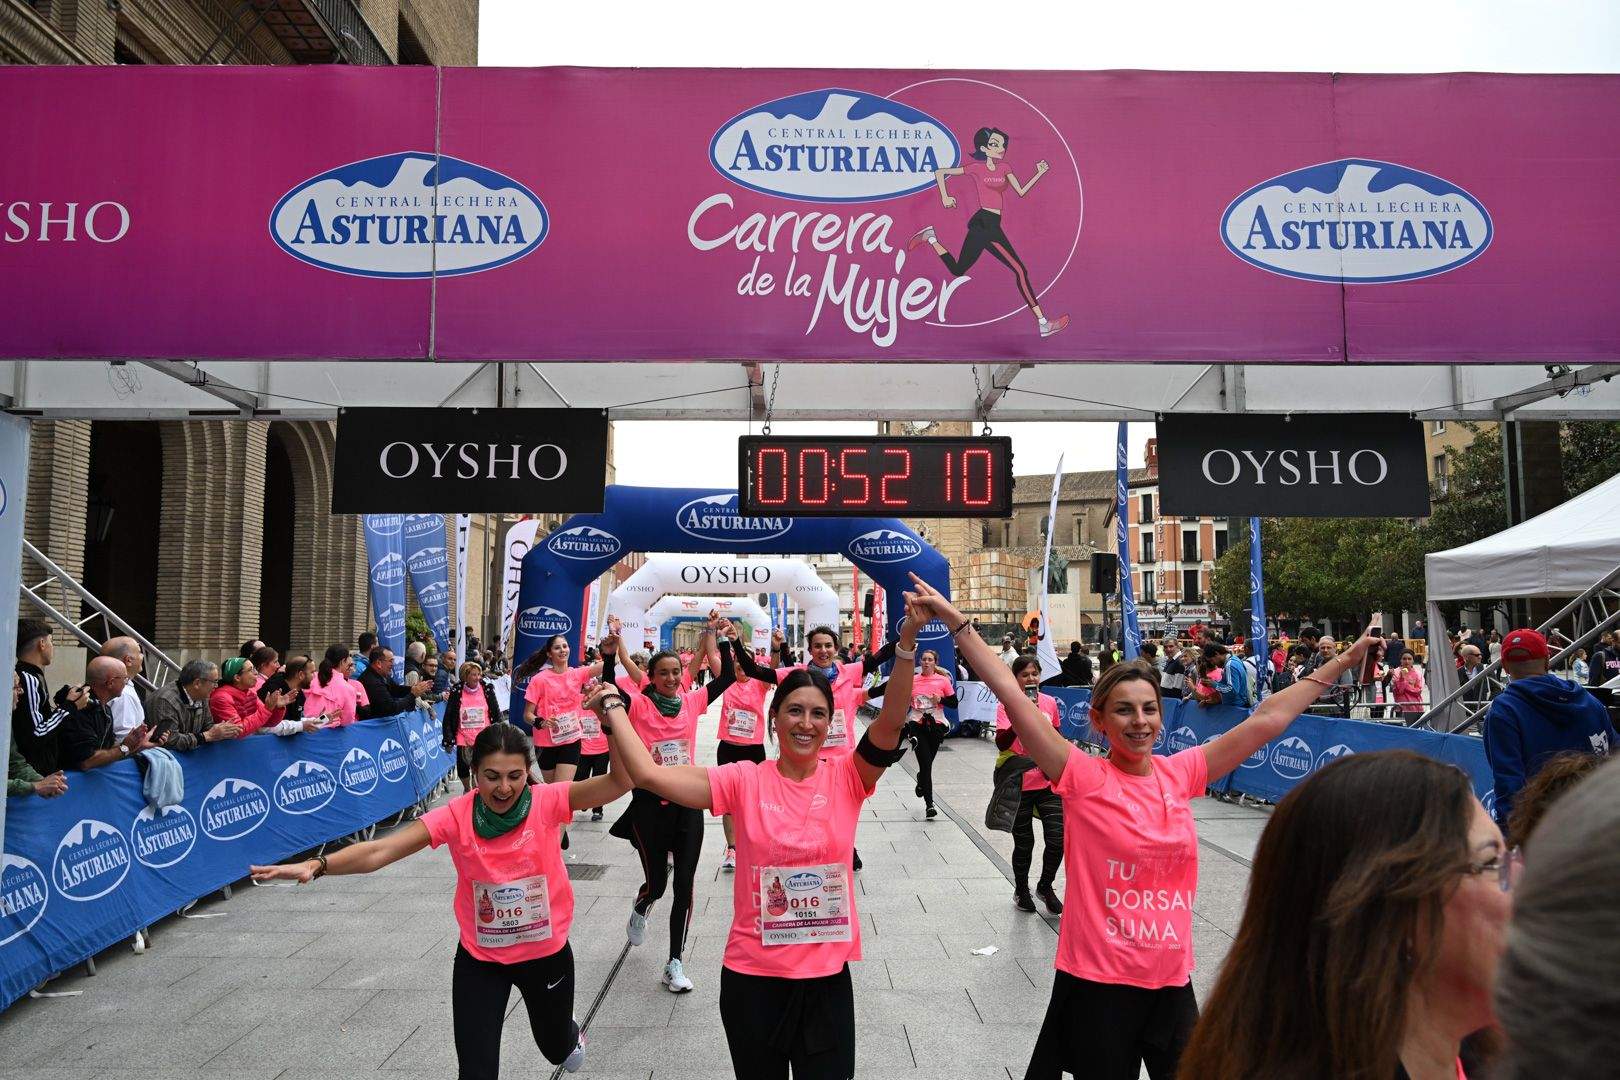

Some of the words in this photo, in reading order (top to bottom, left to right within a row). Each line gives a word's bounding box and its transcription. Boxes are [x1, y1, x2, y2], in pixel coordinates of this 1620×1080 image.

[768, 128, 846, 139] CENTRAL
[855, 129, 932, 140] LECHERA
[729, 130, 938, 173] ASTURIANA
[336, 196, 421, 208] CENTRAL
[431, 196, 518, 208] LECHERA
[1284, 202, 1367, 214] CENTRAL
[1376, 202, 1462, 214] LECHERA
[0, 201, 130, 243] SHO
[291, 198, 527, 245] ASTURIANA
[687, 193, 894, 254] Carrera
[1242, 204, 1473, 251] ASTURIANA
[736, 256, 776, 297] de
[784, 255, 813, 298] la
[806, 249, 971, 347] Mujer
[379, 441, 568, 481] OYSHO
[1201, 449, 1388, 487] OYSHO
[758, 448, 911, 504] 00:52
[946, 449, 992, 504] 10
[685, 508, 784, 530] ASTURIANA
[552, 538, 615, 553] ASTURIANA
[855, 542, 917, 555] ASTURIANA
[681, 565, 771, 584] OYSHO
[1157, 550, 1166, 594] TIBUR
[626, 585, 655, 593] OYSHO
[519, 618, 568, 631] ASTURIANA
[621, 621, 639, 629] SHO
[663, 755, 679, 763] 016
[1273, 749, 1309, 771] ASTURIANA
[344, 766, 377, 787] ASTURIANA
[280, 780, 333, 807] ASTURIANA
[206, 799, 267, 832] ASTURIANA
[137, 824, 193, 858] ASTURIANA
[69, 846, 95, 861] CENTRAL
[61, 846, 128, 891] ASTURIANA
[1106, 858, 1136, 881] TU
[788, 879, 820, 888] ASTURIANA
[496, 906, 523, 919] 016
[790, 896, 820, 909] 016
[769, 932, 797, 940] OYSHO
[1105, 916, 1178, 941] SUMA
